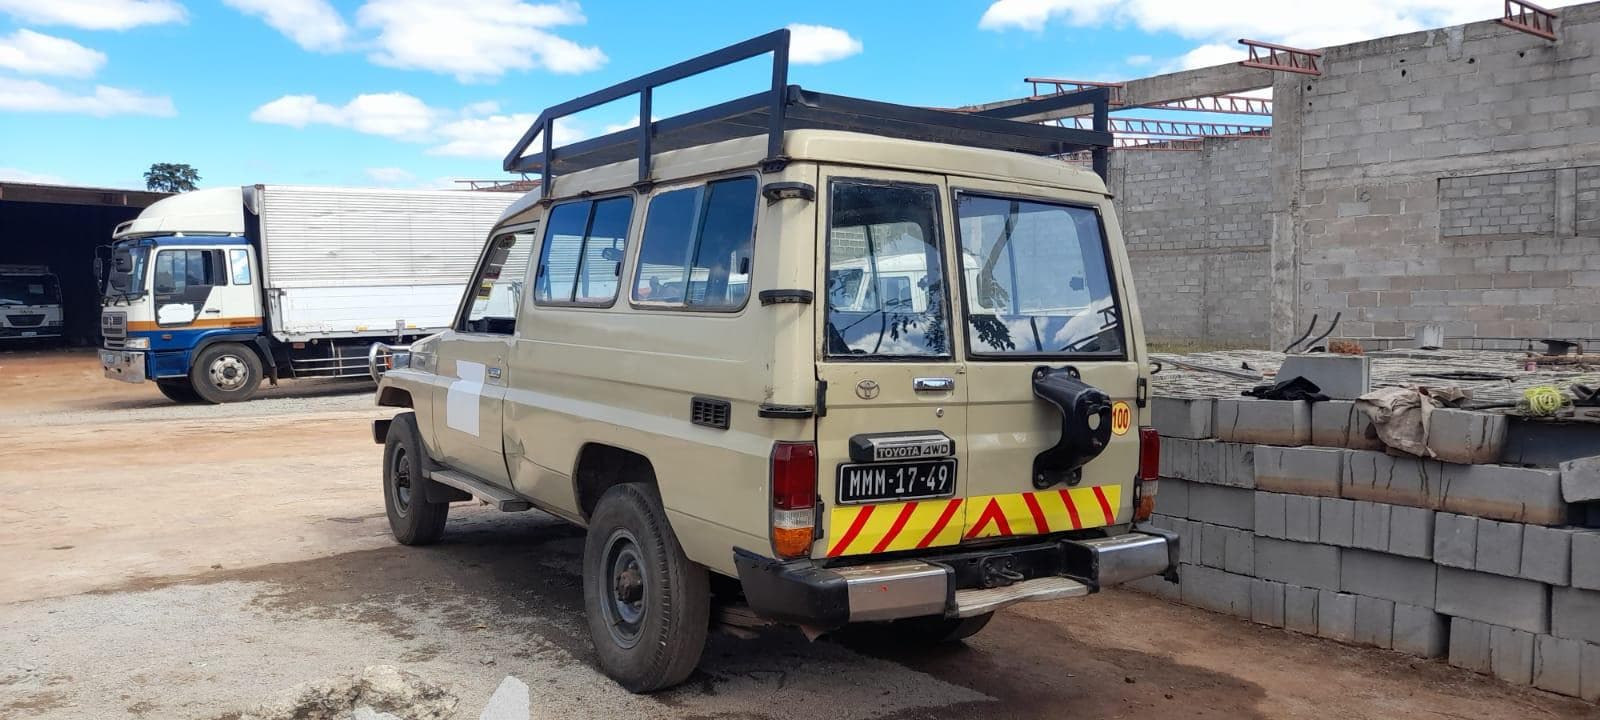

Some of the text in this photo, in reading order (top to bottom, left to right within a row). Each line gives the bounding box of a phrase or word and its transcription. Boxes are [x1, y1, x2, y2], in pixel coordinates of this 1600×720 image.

[1113, 408, 1128, 428] 100
[878, 444, 948, 457] TOYOTA 4WD
[849, 465, 948, 496] MMM-17-49
